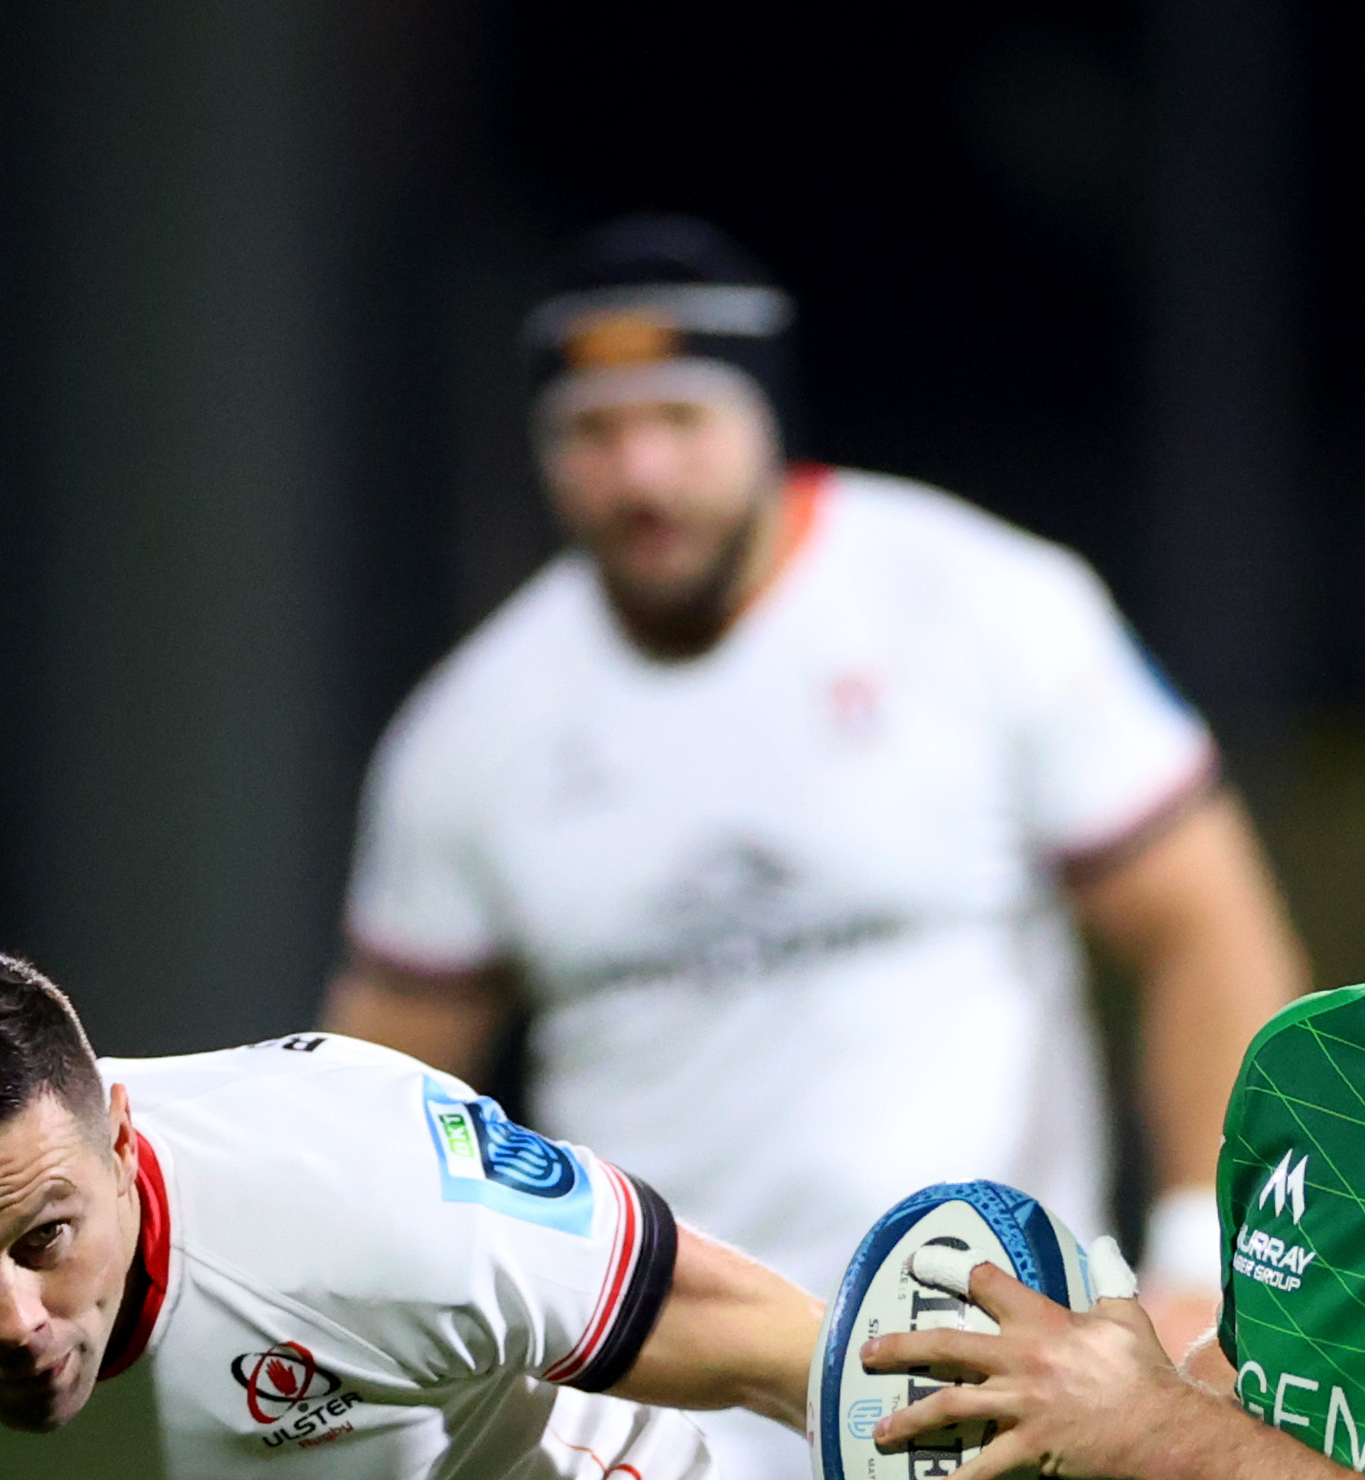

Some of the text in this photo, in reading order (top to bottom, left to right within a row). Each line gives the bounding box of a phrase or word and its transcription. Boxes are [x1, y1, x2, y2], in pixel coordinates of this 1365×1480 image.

[1237, 1223, 1317, 1275] URRAY
[1253, 1264, 1302, 1292] GROUP
[262, 1392, 363, 1447] ULSTER
